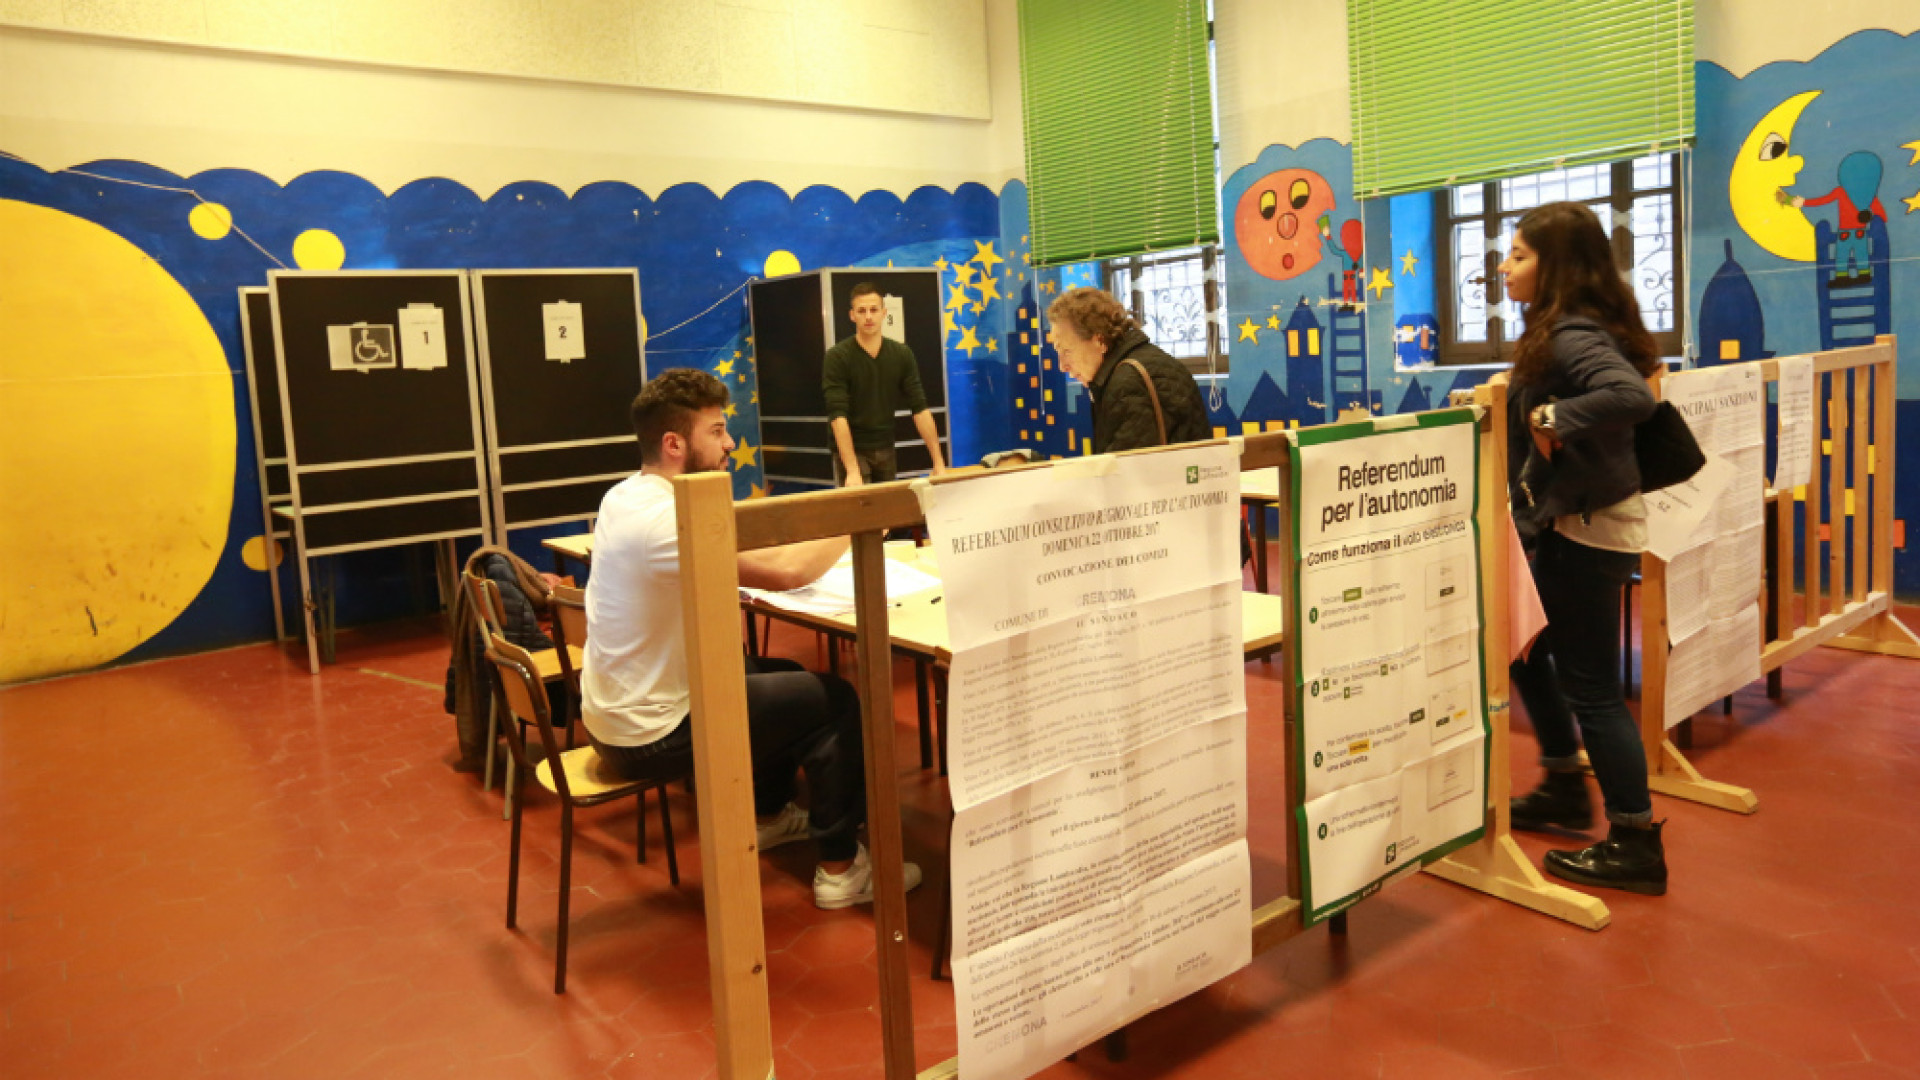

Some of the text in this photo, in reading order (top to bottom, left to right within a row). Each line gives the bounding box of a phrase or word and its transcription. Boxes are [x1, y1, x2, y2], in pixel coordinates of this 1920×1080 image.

[423, 331, 430, 345] 1
[558, 326, 568, 339] 2
[1338, 454, 1445, 491] Referendum
[1320, 478, 1456, 533] per l'autonomia
[951, 523, 1030, 555] REFERENDUM
[1151, 498, 1168, 516] PER
[1042, 533, 1092, 557] DOMENICA
[1092, 532, 1101, 546] 22
[1103, 524, 1144, 543] OTTOBRE
[1307, 549, 1338, 567] Come
[1341, 538, 1391, 559] funziona
[1393, 535, 1401, 549] il
[1403, 529, 1421, 546] voto
[1036, 548, 1168, 586] CONVOCAZIONE DEI COMIZI
[994, 607, 1049, 632] COMUNE DI
